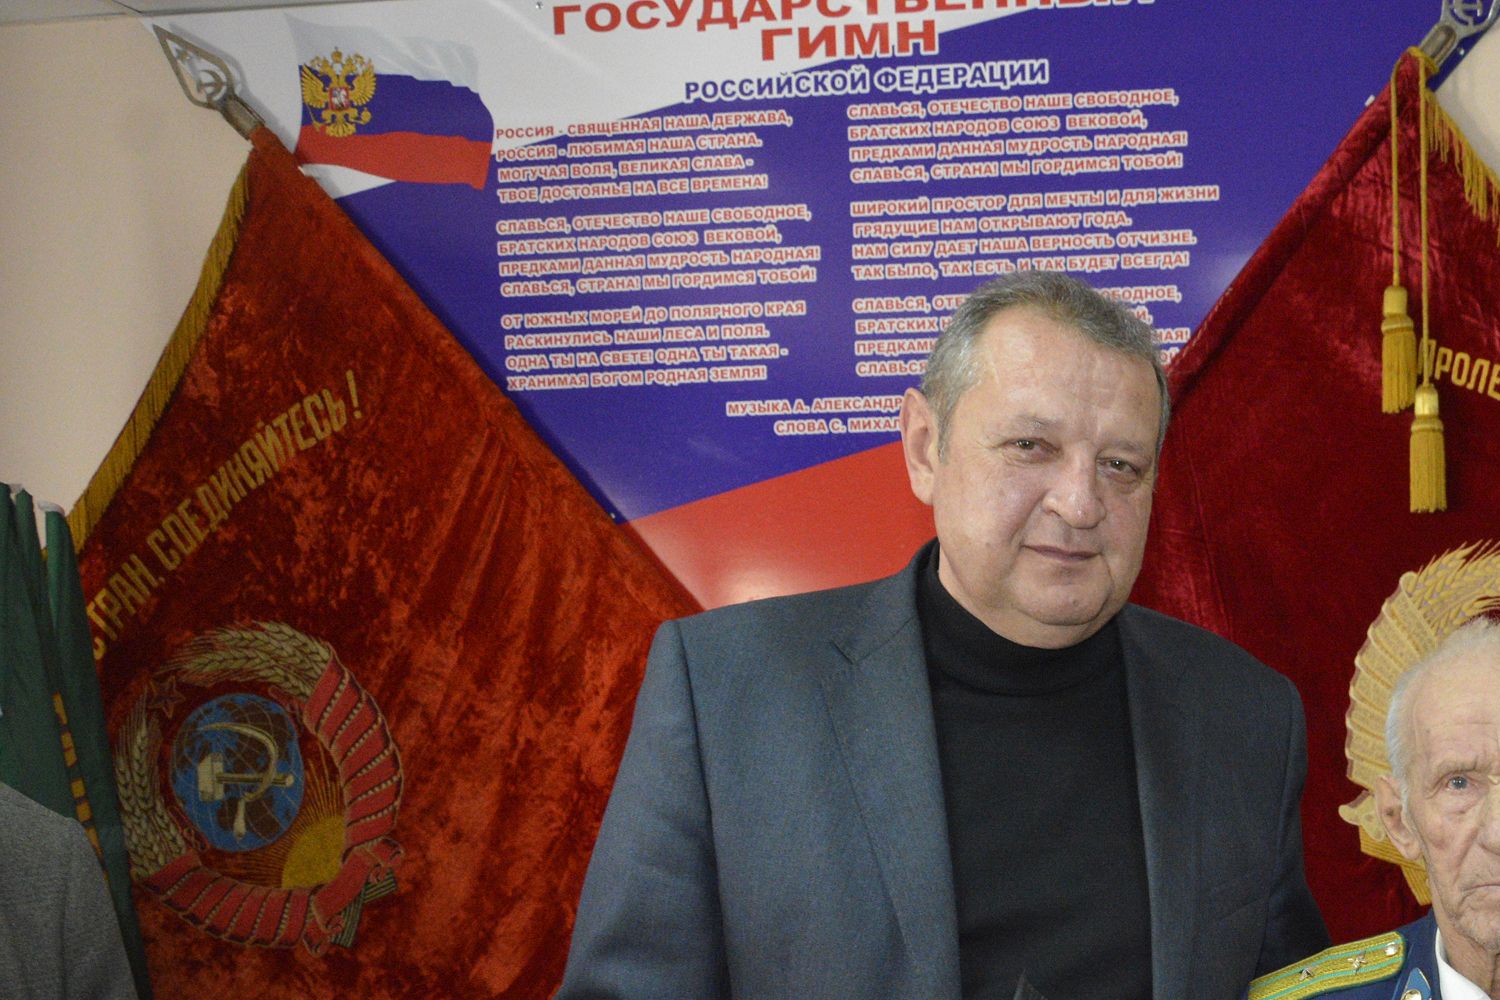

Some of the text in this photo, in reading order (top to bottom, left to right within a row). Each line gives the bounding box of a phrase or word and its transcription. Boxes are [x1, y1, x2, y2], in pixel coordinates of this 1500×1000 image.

[761, 20, 937, 61] ГИМН
[685, 62, 1047, 100] РОССИЙСКОЙ ФЕДЕРАЦИИ
[849, 91, 1176, 118] СЛАВЬСЯ, ОТЕЧЕСТВО НАШЕ СВОБОДНОЕ,
[496, 113, 790, 139] РОССИЯ СВЯЩЕННАЯ НАША ДЕРЖАВА,
[850, 111, 1146, 139] БРАТСКИХ НАРОДОВ СОЮЗ ВЕКОВОЙ,
[498, 135, 760, 160] РОССИЯ ЛЮБИМАЯ НАША СТРАНА.
[851, 134, 1185, 161] ПРЕДКАМИ ДАННАЯ МУДРОСТЬ НАРОДНАЯ!
[500, 158, 743, 180] МОГУЧАЯ ВОЛЯ, ВЕЛИКАЯ СЛАВА
[852, 152, 1181, 180] СЛАВЬСЯ, СТРАНА! МЫ ГОРДИМСЯ ТОБОЙ!
[500, 176, 766, 202] ТВОЕ ДОСТОЯНЬЕ НА ВСЕ ВРЕМЕНА!
[852, 188, 1217, 215] ШИРОКИЙ ПРОСТОР ДЛЯ МЕЧТЫ И ДЛЯ ЖИЗНИ
[498, 206, 809, 233] СЛАВЬСЯ, ОТЕЧЕСТВО НАШЕ СВОБОДНОЕ,
[855, 213, 1130, 237] ГРЯДУЩИЕ НАМ ОТКРЫВАЮТ ГОДА.
[499, 226, 780, 253] БРАТСКИХ НАРОДОВ СОЮЗ ВЕКОВОЙ,
[854, 231, 1195, 256] НАМ СИЛУ ДАЕТ НАША ВЕРНОСТЬ ОТЧИЗНЕ.
[501, 247, 818, 275] ПРЕДКАМИ ДАННАЯ МУДРОСТЬ НАРОДНАЯ!
[854, 254, 1187, 278] ТАК БЫЛО, ТАК ЕСТЬ И ТАК БУДЕТ ВСЕГДА!
[504, 266, 814, 295] СЛАВЬСЯ, СТРАНА! МЫ ГОРДИМСЯ ТОБОЙ!
[503, 302, 804, 327] ОТ ЮЖНЫХ МОРЕЙ ДО ПОЛЯРНОГО КРАЯ
[854, 299, 929, 312] СЛАВЬСЯ,
[507, 325, 768, 348] РАСКИНУЛИСЬ НАШИ ЛЕСА И ПОЛЯ.
[857, 320, 938, 333] БРАТСКИХ
[509, 345, 786, 370] ОДНА ТЫ НА СВЕТЕ! ОДНА ТЫ ТАКАЯ
[510, 367, 765, 389] ХРАНИМАЯ БОГОМ РОДНАЯ ЗЕМЛЯ!
[728, 401, 790, 414] МУЗЫКА
[776, 420, 826, 433] СЛОВА
[147, 369, 362, 570] СОЕДИНЯЙТЕСЬ!
